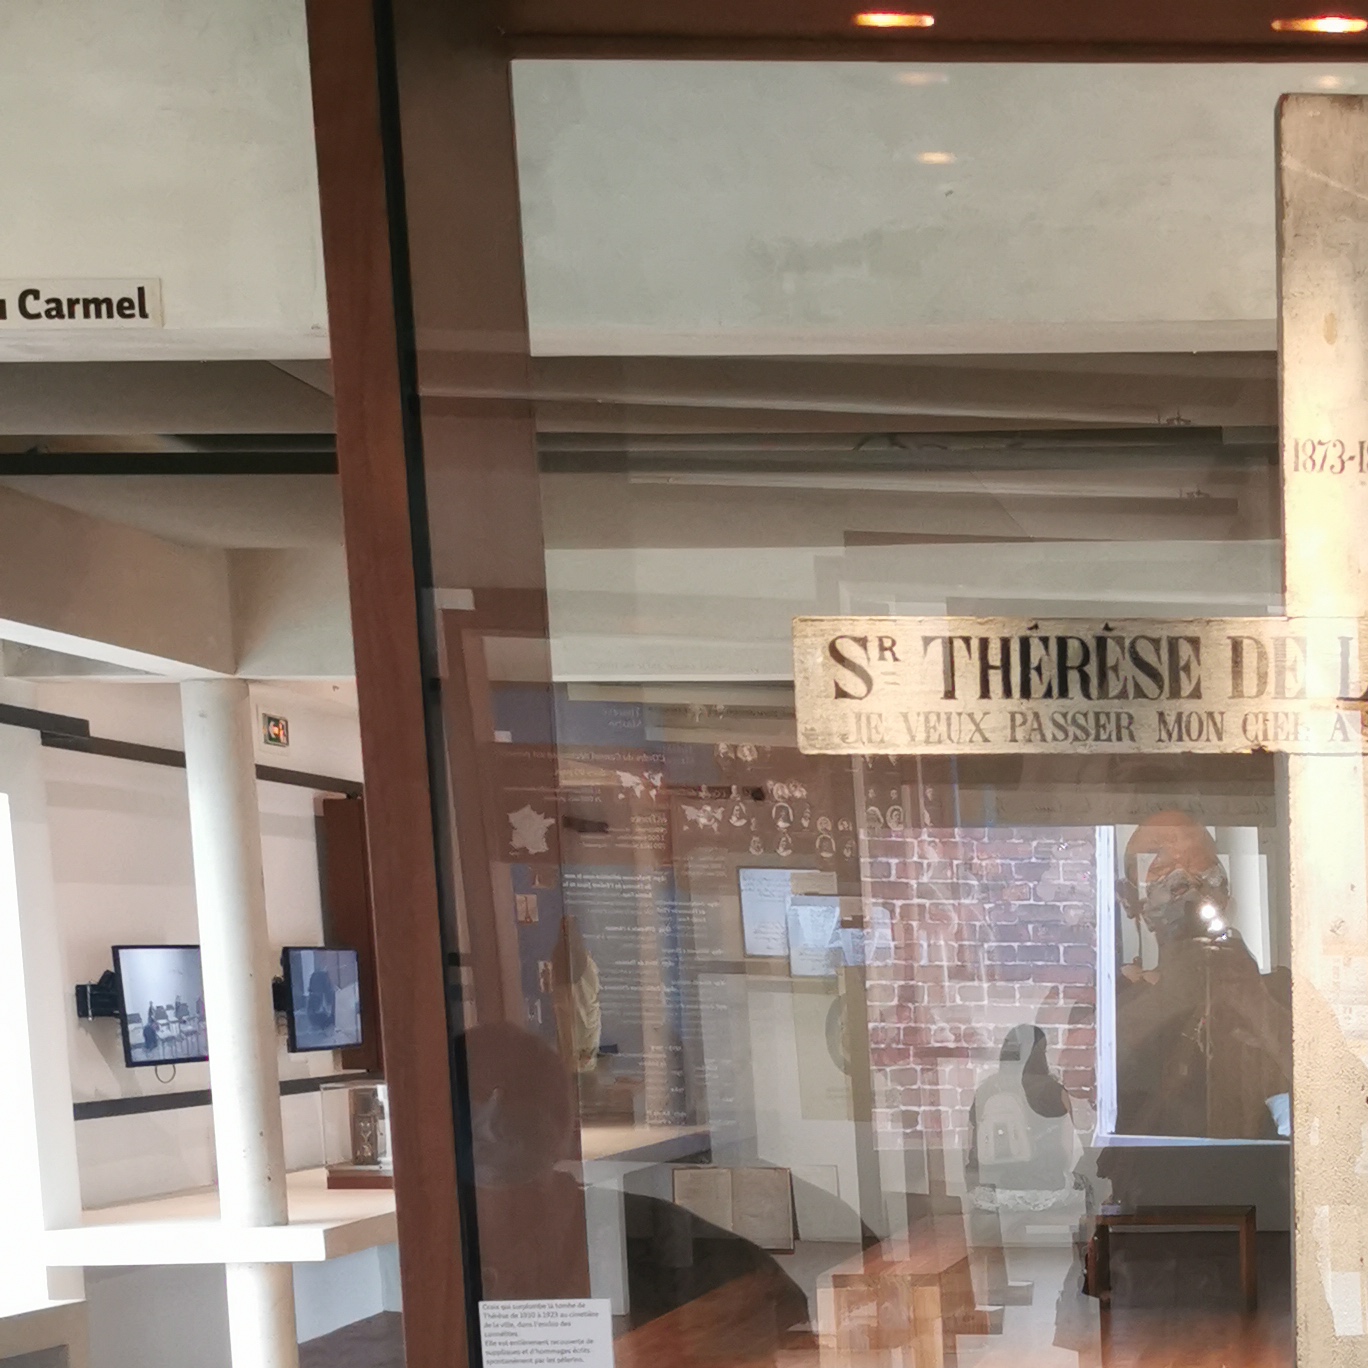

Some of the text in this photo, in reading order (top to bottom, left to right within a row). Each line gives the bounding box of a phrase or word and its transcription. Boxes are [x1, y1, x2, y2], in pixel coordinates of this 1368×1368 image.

[17, 286, 149, 320] Carmel
[1227, 634, 1310, 700] DE
[841, 711, 886, 745] JE
[902, 711, 989, 744] VEUX
[1009, 709, 1135, 744] PASSER
[1156, 710, 1225, 743] MON
